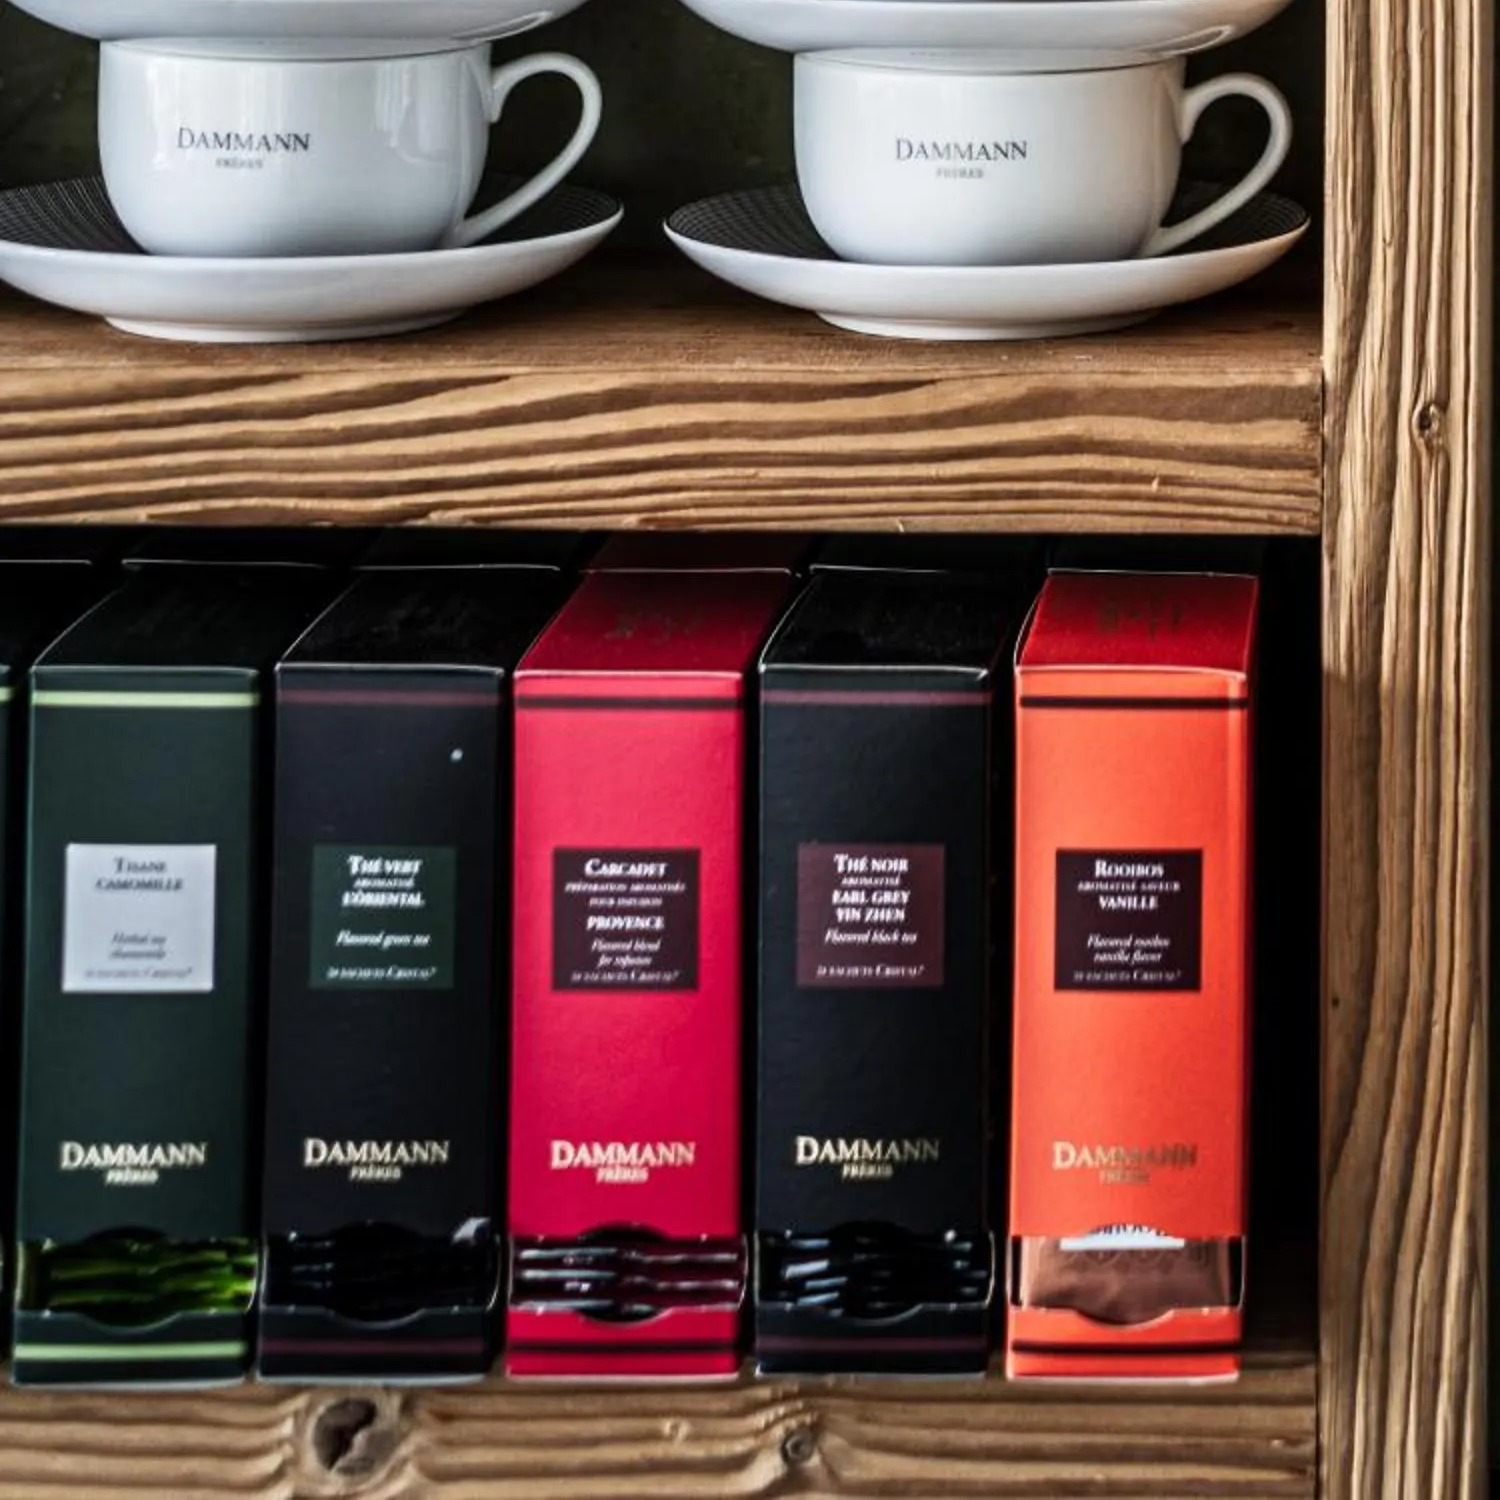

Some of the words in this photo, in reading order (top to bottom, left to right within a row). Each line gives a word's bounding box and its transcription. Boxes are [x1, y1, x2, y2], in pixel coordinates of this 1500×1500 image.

[178, 127, 310, 153] DAMMANN
[896, 138, 1027, 161] DAMMANN
[585, 858, 668, 876] CARCADET
[871, 858, 909, 872] NOIR
[1095, 859, 1163, 878] ROOIBOS
[832, 890, 869, 904] EARL
[872, 890, 911, 904] GREY
[1099, 895, 1159, 910] VANILLE
[586, 916, 664, 930] PROVENCE
[60, 1141, 207, 1169] DAMMANN
[304, 1138, 449, 1167] DAMMANN
[551, 1139, 696, 1169] DAMMANN
[796, 1136, 939, 1165] DAMMANN
[1053, 1141, 1198, 1170] DAMMANN
